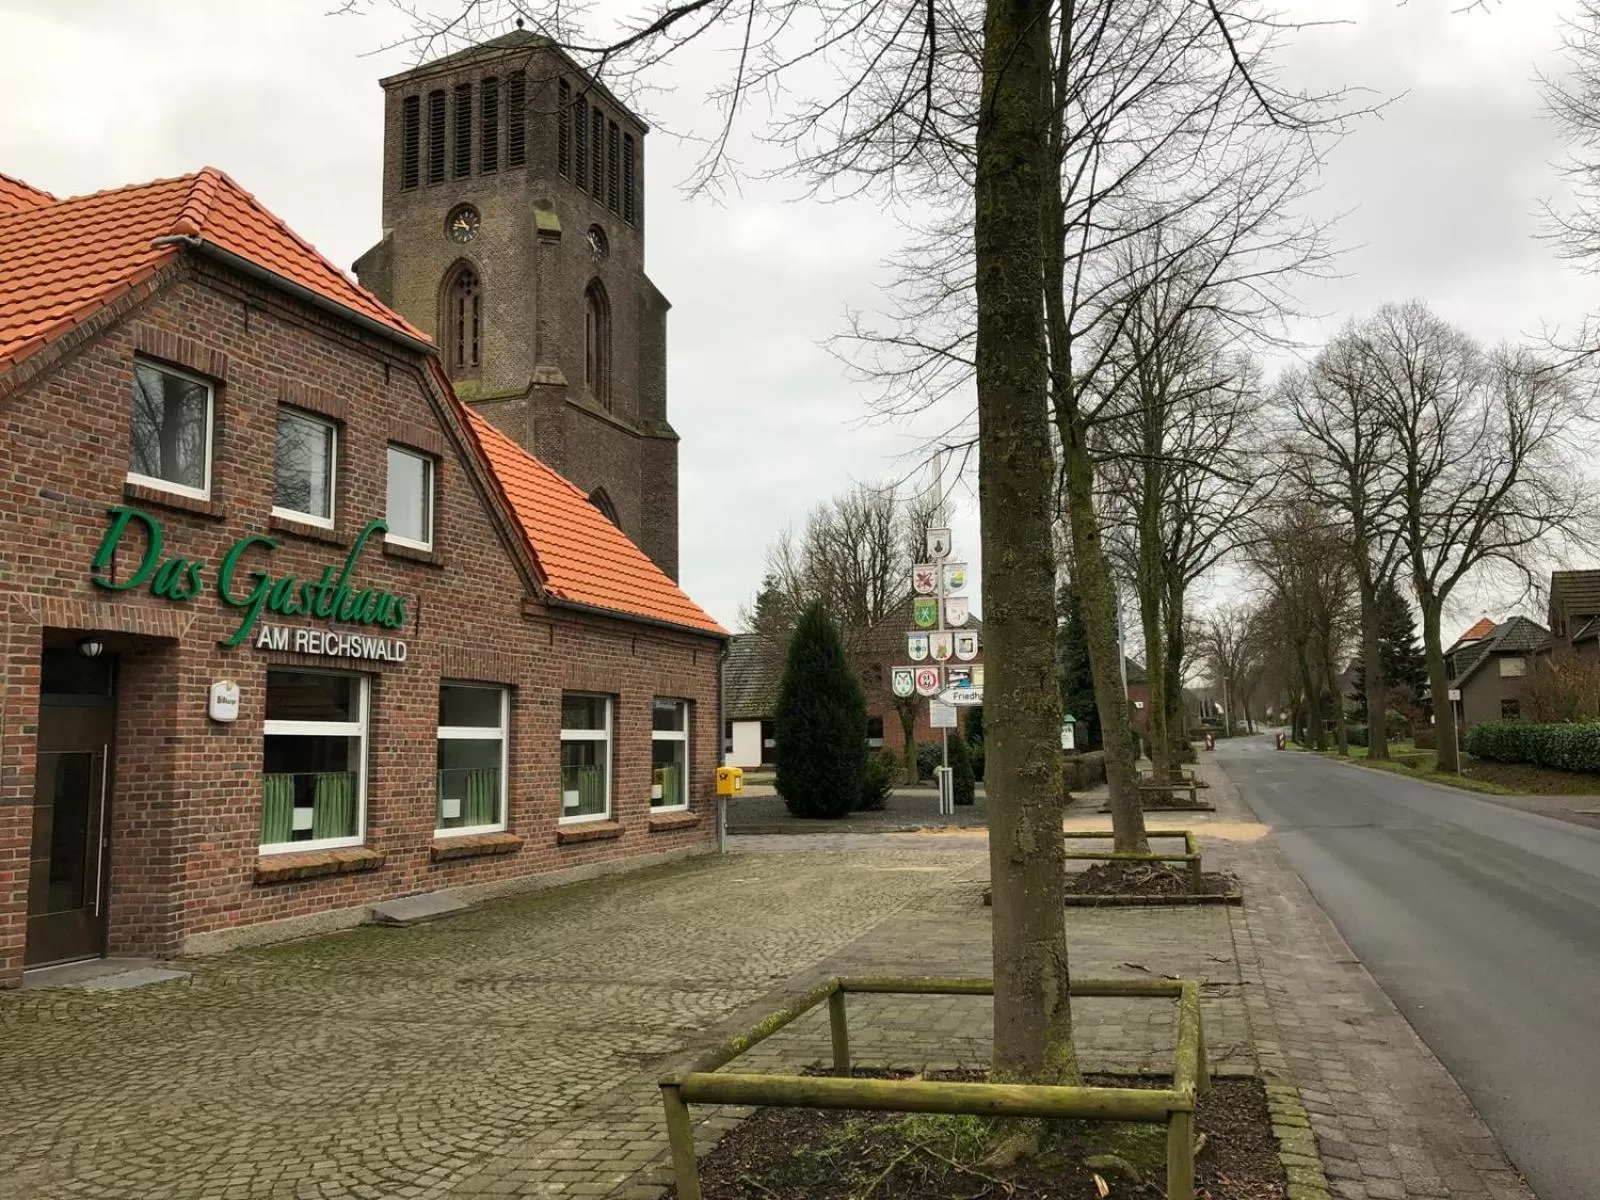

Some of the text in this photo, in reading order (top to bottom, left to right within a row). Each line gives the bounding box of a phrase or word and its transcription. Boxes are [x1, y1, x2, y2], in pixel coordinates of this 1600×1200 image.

[92, 508, 407, 647] Das Gasthaus
[256, 627, 407, 662] AM REICHSWALD
